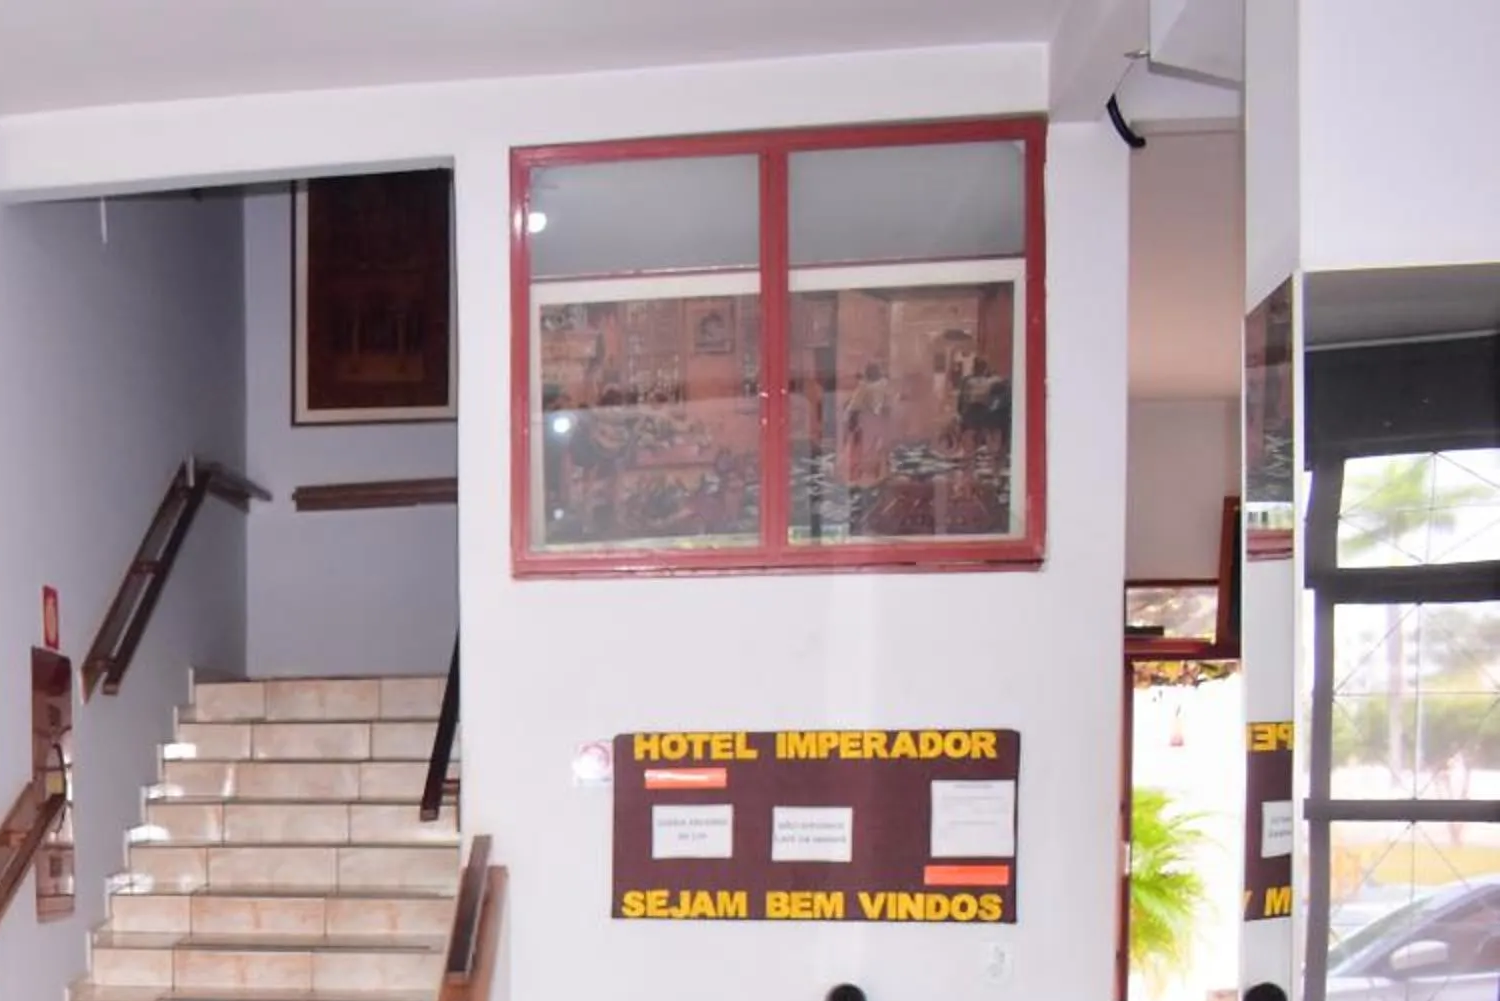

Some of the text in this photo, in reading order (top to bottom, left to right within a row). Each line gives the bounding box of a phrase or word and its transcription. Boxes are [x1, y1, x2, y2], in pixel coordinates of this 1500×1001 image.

[633, 730, 998, 761] HOTEL IMPERADOR
[621, 889, 1004, 923] SEJAM BEM VINDOS
